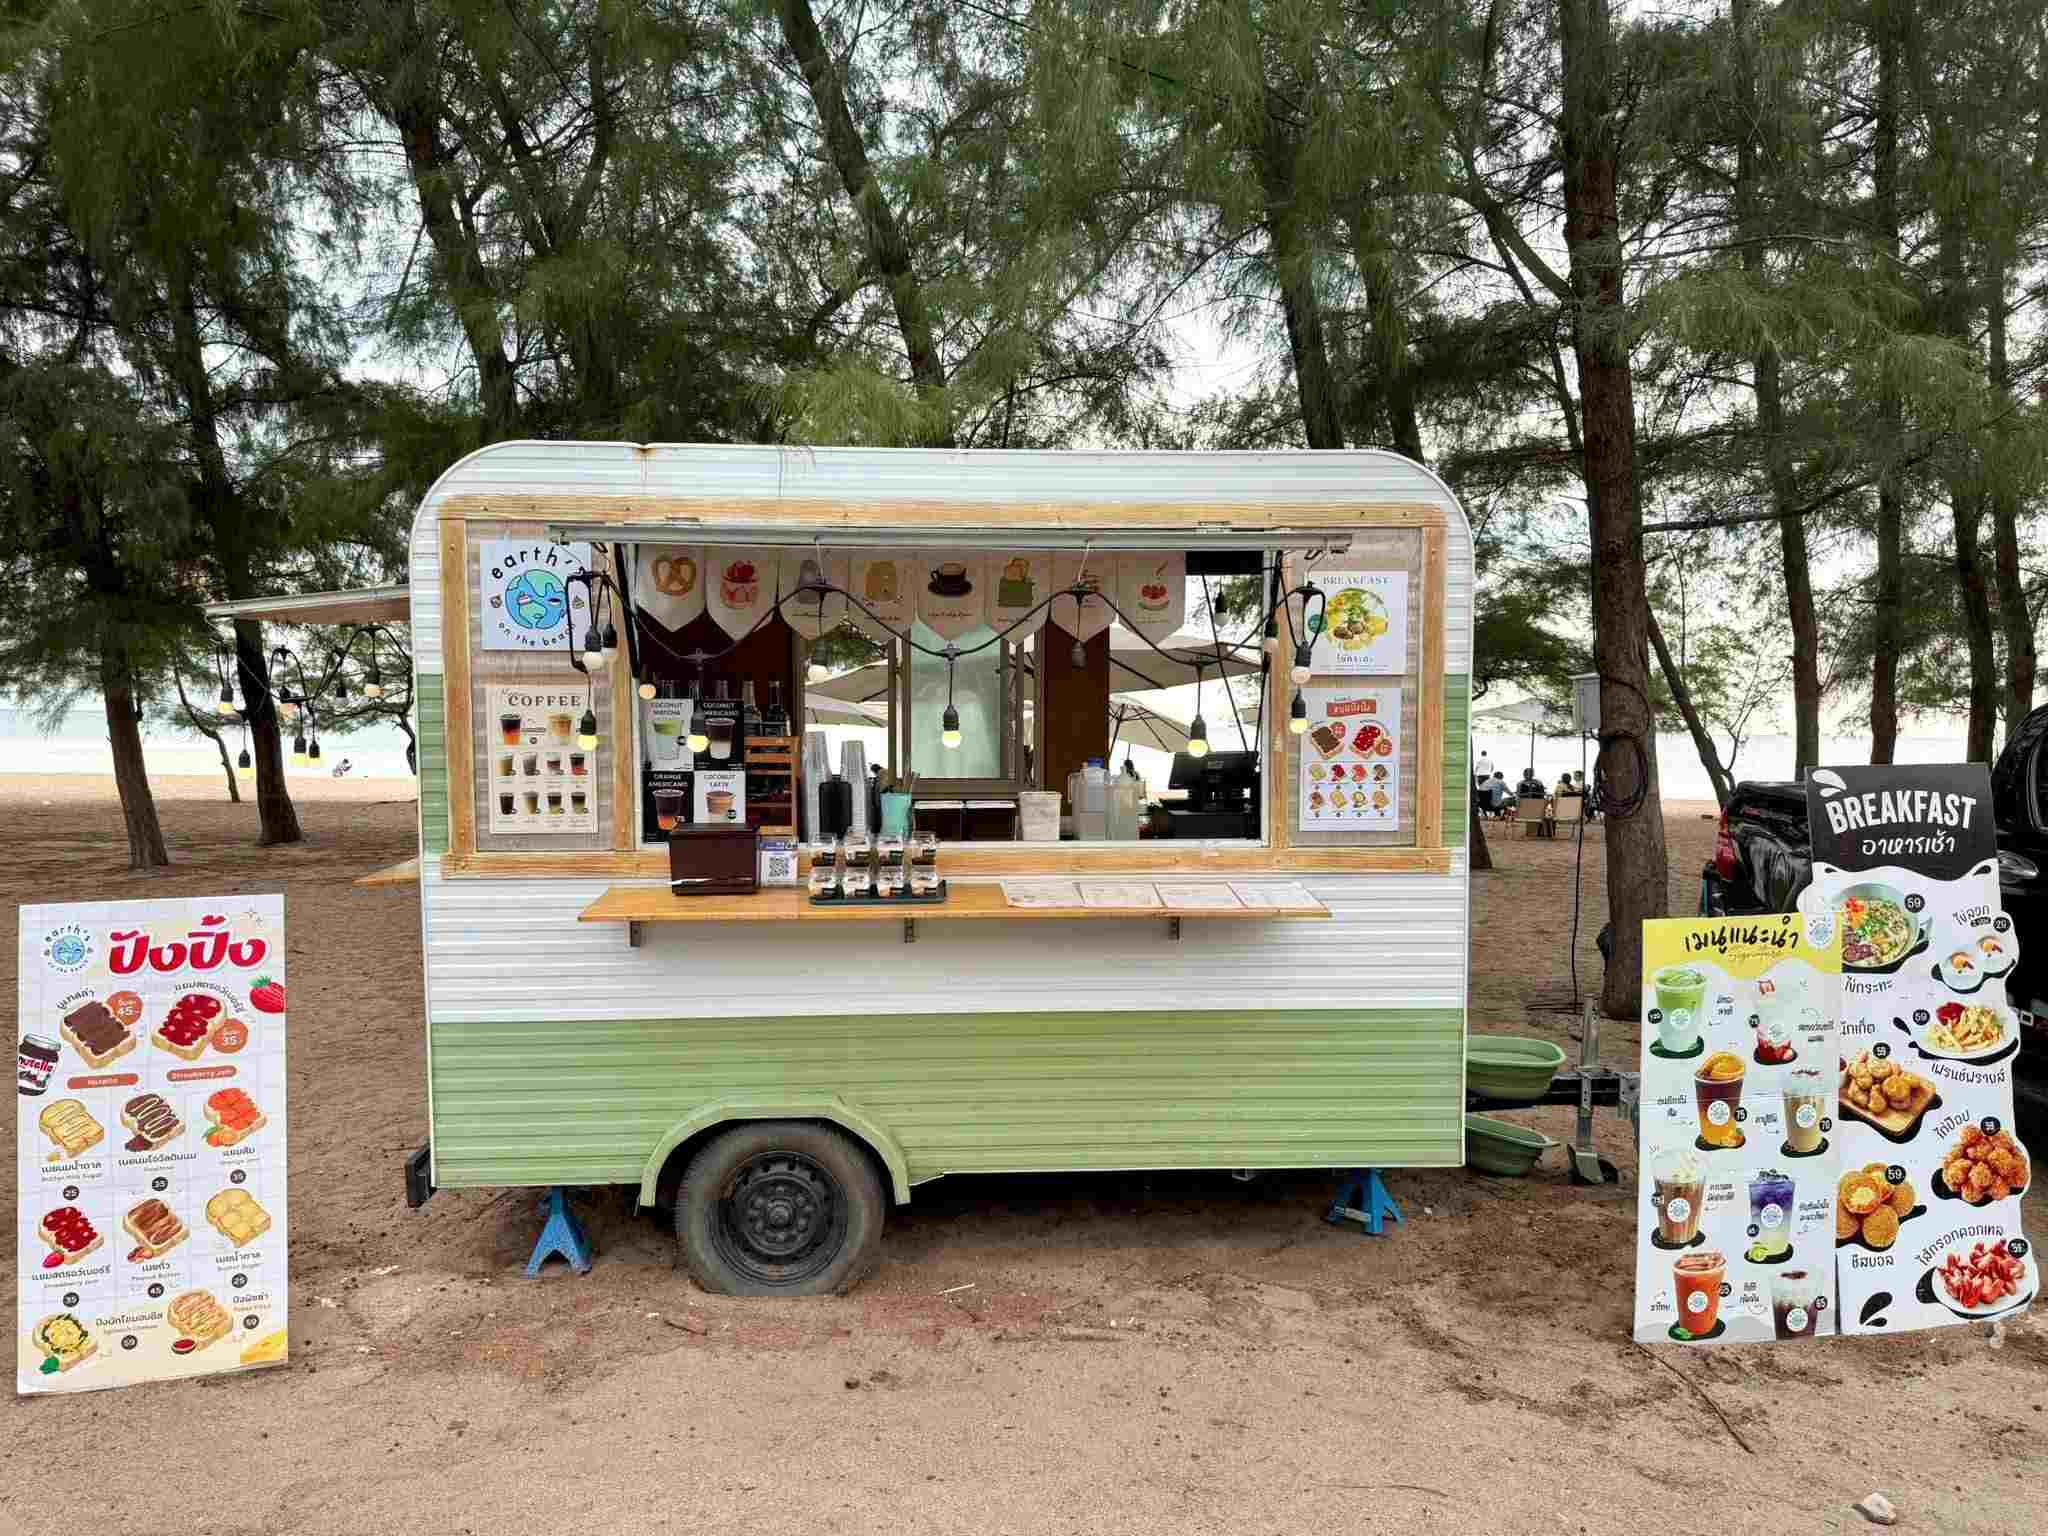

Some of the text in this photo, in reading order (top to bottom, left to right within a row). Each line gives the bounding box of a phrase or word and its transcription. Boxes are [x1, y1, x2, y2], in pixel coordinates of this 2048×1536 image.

[516, 634, 536, 647] the
[508, 695, 582, 706] COFFEE
[1825, 790, 1977, 835] BREAKFAST
[1862, 829, 1956, 855] อาหารเช้า
[1907, 897, 1921, 908] 59
[1685, 915, 1799, 954] เมนูแนะนำ
[109, 915, 267, 975] ปังปิ้ง
[1888, 1168, 1902, 1179] 59
